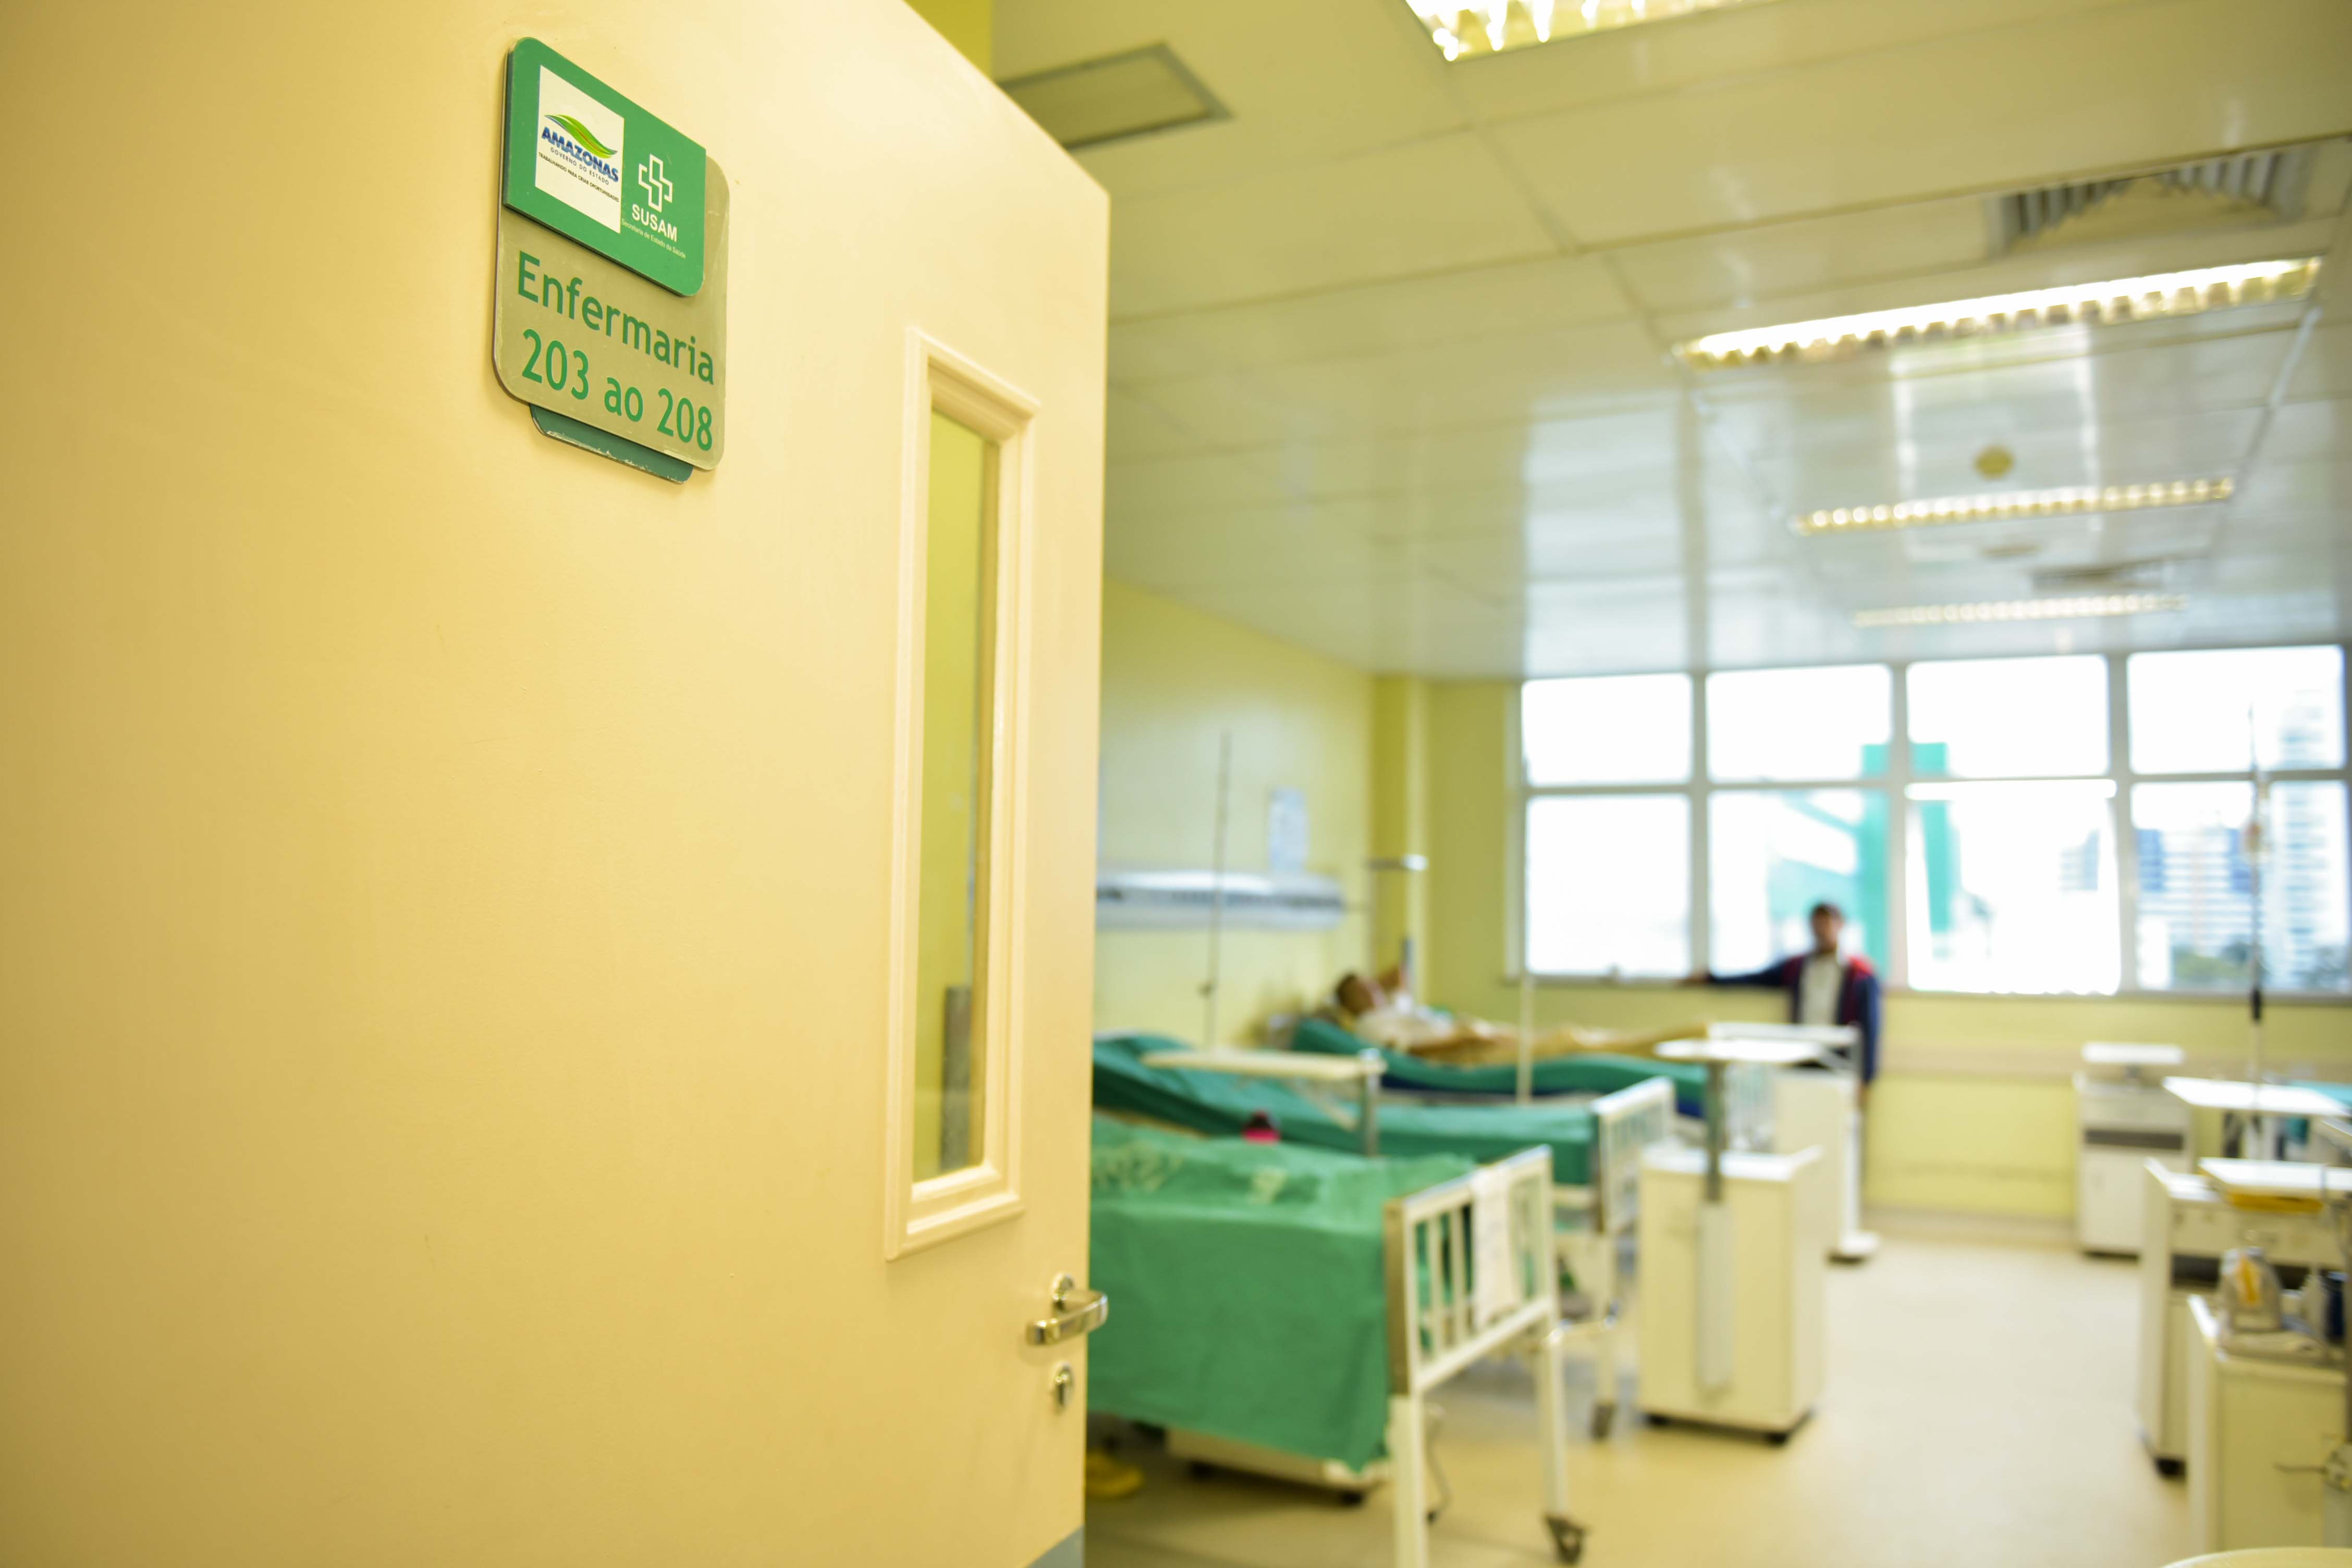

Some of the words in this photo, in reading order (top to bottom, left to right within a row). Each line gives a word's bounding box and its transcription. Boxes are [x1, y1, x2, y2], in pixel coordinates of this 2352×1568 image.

[538, 152, 567, 172] TRABALHANDO
[567, 169, 577, 178] PARA
[578, 175, 590, 185] CRIAR
[590, 182, 619, 202] OPORTUNIDADES
[542, 126, 619, 182] AMAZONAS
[550, 147, 577, 166] GOVERNO
[589, 170, 609, 185] ESTADO
[621, 218, 644, 236] Secretaria
[651, 235, 666, 248] Estado
[632, 204, 677, 242] SUSAM
[518, 250, 714, 385] Enfermaria
[522, 329, 589, 400] 203
[604, 377, 643, 422] ao
[657, 388, 713, 451] 208
